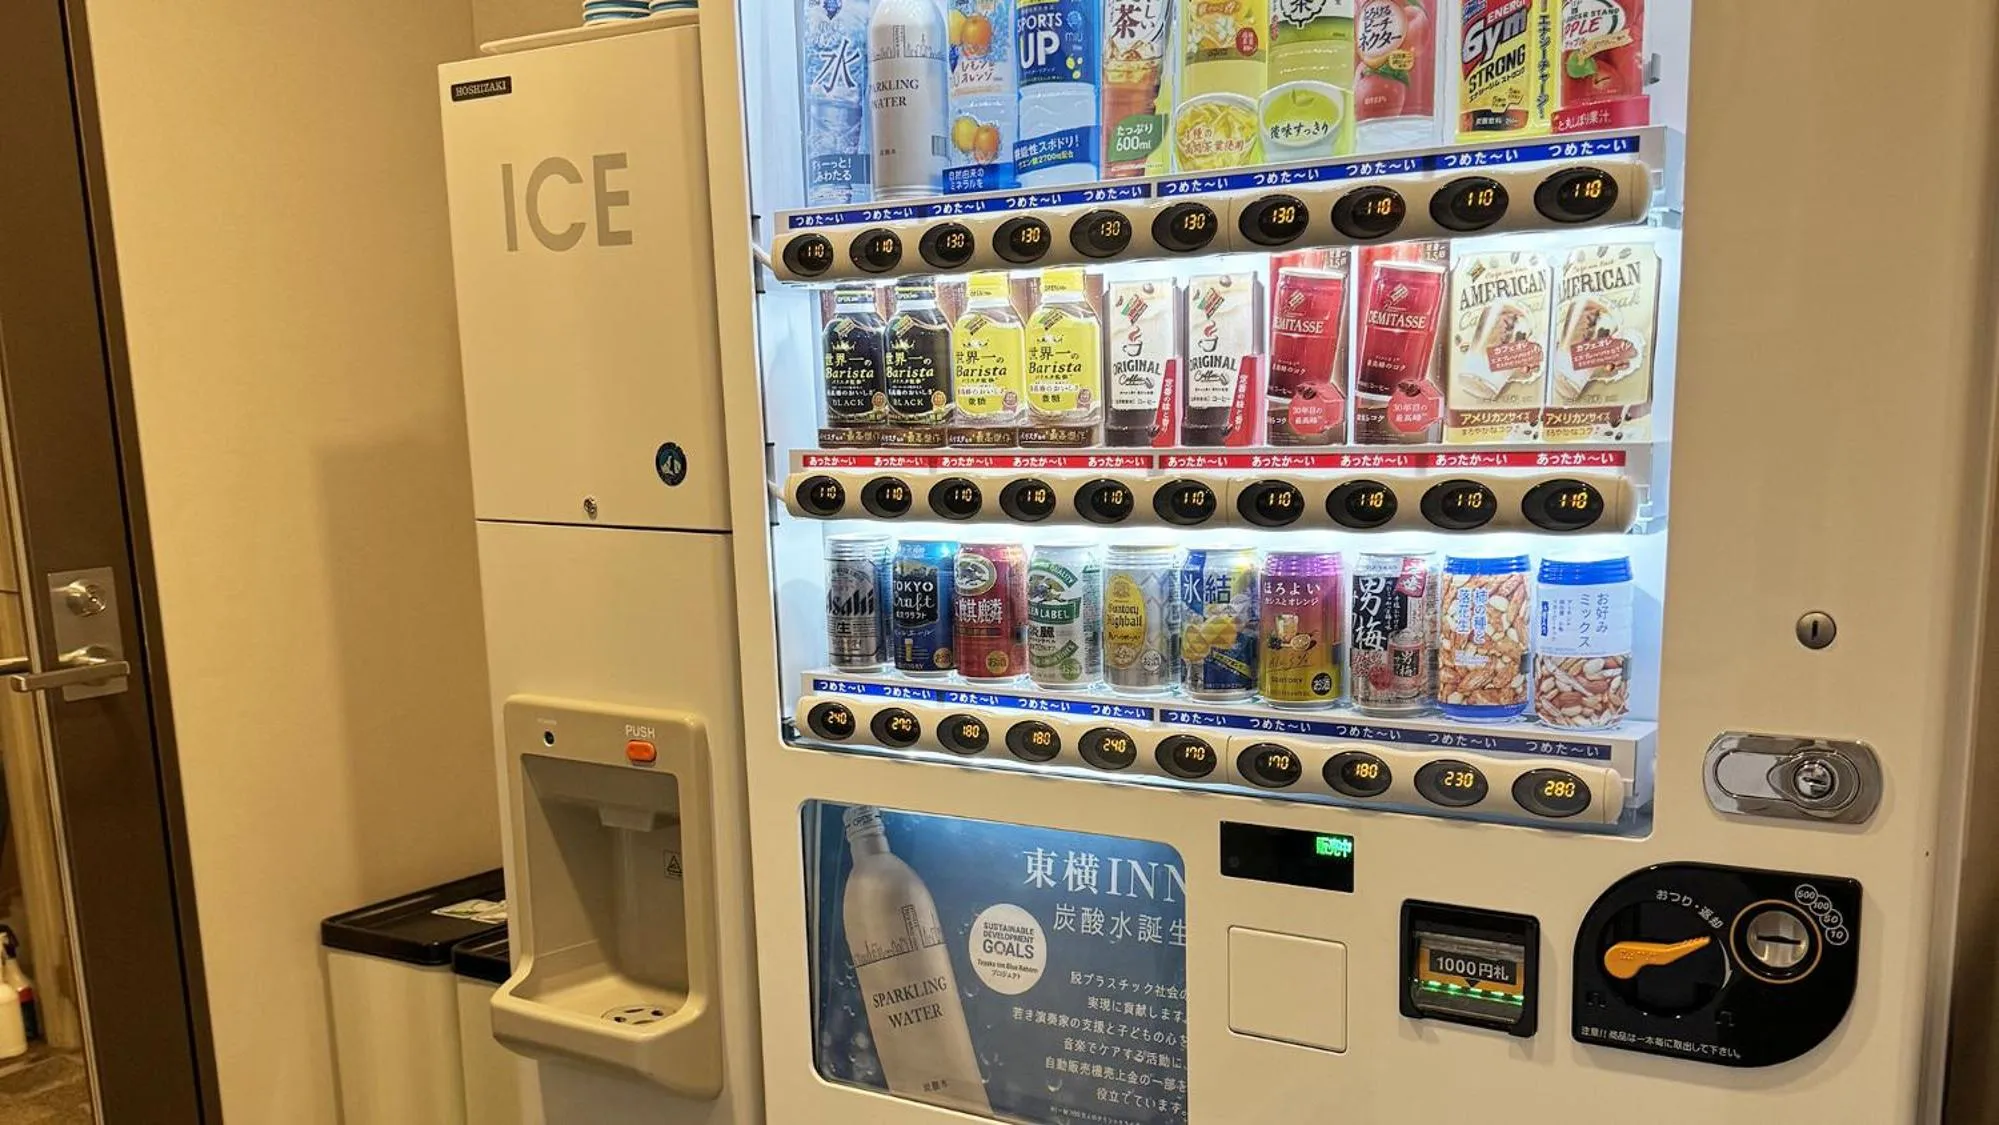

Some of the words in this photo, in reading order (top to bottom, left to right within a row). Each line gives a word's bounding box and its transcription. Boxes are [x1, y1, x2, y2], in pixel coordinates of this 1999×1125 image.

[1591, 8, 1620, 18] STAND
[1017, 13, 1062, 32] SPORTS
[1111, 4, 1141, 39] 茶
[1364, 17, 1392, 33] ピーチ
[1359, 30, 1402, 51] ネクター
[1020, 31, 1060, 69] UP
[815, 38, 860, 93] 水
[1469, 44, 1526, 94] STRONG
[455, 80, 507, 97] HOSHIZAKI
[1116, 124, 1153, 136] たっぷり
[1116, 135, 1151, 152] 600ml
[1574, 180, 1601, 198] 110
[501, 152, 633, 252] ICE
[1467, 189, 1493, 206] 110
[1366, 197, 1391, 215] 110
[1184, 213, 1206, 230] 130
[1272, 206, 1295, 223] 130
[1021, 227, 1041, 243] 130
[1101, 221, 1120, 236] 130
[875, 238, 893, 253] 110
[946, 232, 965, 248] 130
[807, 244, 824, 258] 110
[1561, 261, 1641, 300] MERICAN
[1459, 269, 1547, 311] AMERICAN
[1273, 316, 1324, 334] EMITASSE
[825, 352, 872, 366] 世界一の
[885, 351, 932, 366] 世界一の
[956, 350, 1004, 364] 世界一の
[1029, 346, 1080, 360] 世界一の
[825, 366, 874, 378] Barista
[886, 366, 934, 378] Barista
[956, 364, 1007, 377] Barista
[1029, 360, 1082, 374] Barista
[1292, 406, 1323, 415] 30年目の
[1392, 403, 1428, 412] 30年目の
[1460, 411, 1530, 426] アメリカンサイズ
[1546, 411, 1611, 425] アメリカンサイズ
[820, 486, 836, 500] 110
[886, 487, 903, 501] 110
[954, 488, 972, 502] 110
[1027, 488, 1045, 503] 110
[1103, 490, 1122, 504] 110
[1183, 491, 1204, 505] 110
[1268, 491, 1291, 507] 110
[1360, 492, 1384, 507] 110
[1457, 492, 1482, 508] 110
[1560, 492, 1588, 509] 110
[894, 581, 934, 593] TOKYO
[1184, 574, 1231, 604] 氷結
[1264, 582, 1320, 595] ほろよい
[1265, 597, 1319, 606] カシスとオレンジ
[955, 598, 1002, 624] 麒麟
[1040, 609, 1069, 619] LABEL
[1595, 593, 1610, 633] お好み
[837, 621, 852, 634] 生
[1577, 593, 1591, 648] ミックス
[827, 711, 847, 725] 240
[625, 724, 656, 739] PUSH
[962, 724, 979, 738] 180
[1033, 731, 1051, 745] 180
[1103, 737, 1126, 752] 240
[1185, 746, 1205, 760] 170
[1268, 755, 1289, 770] 170
[1355, 762, 1378, 779] 180
[1444, 771, 1474, 788] 230
[1544, 780, 1575, 798] 280
[1023, 847, 1187, 903] 東横INN
[1796, 889, 1816, 900] 500
[1655, 889, 1724, 930] おつり・返却
[1813, 900, 1829, 911] 100
[1053, 903, 1187, 947] 炭酸水誕生
[1823, 914, 1839, 925] 50
[983, 922, 1034, 935] SUSTAINABLE
[1830, 930, 1843, 940] 10
[983, 930, 1034, 943] DEVELOPMENT
[983, 939, 1034, 959] GOALS
[1436, 955, 1509, 981] 1000円札
[872, 976, 947, 1009] SPARKLING
[1069, 970, 1188, 1001] 脱プラスチック社会の
[888, 1003, 943, 1030] WATER
[1045, 1056, 1188, 1093] 自動販売機売上金の一部を
